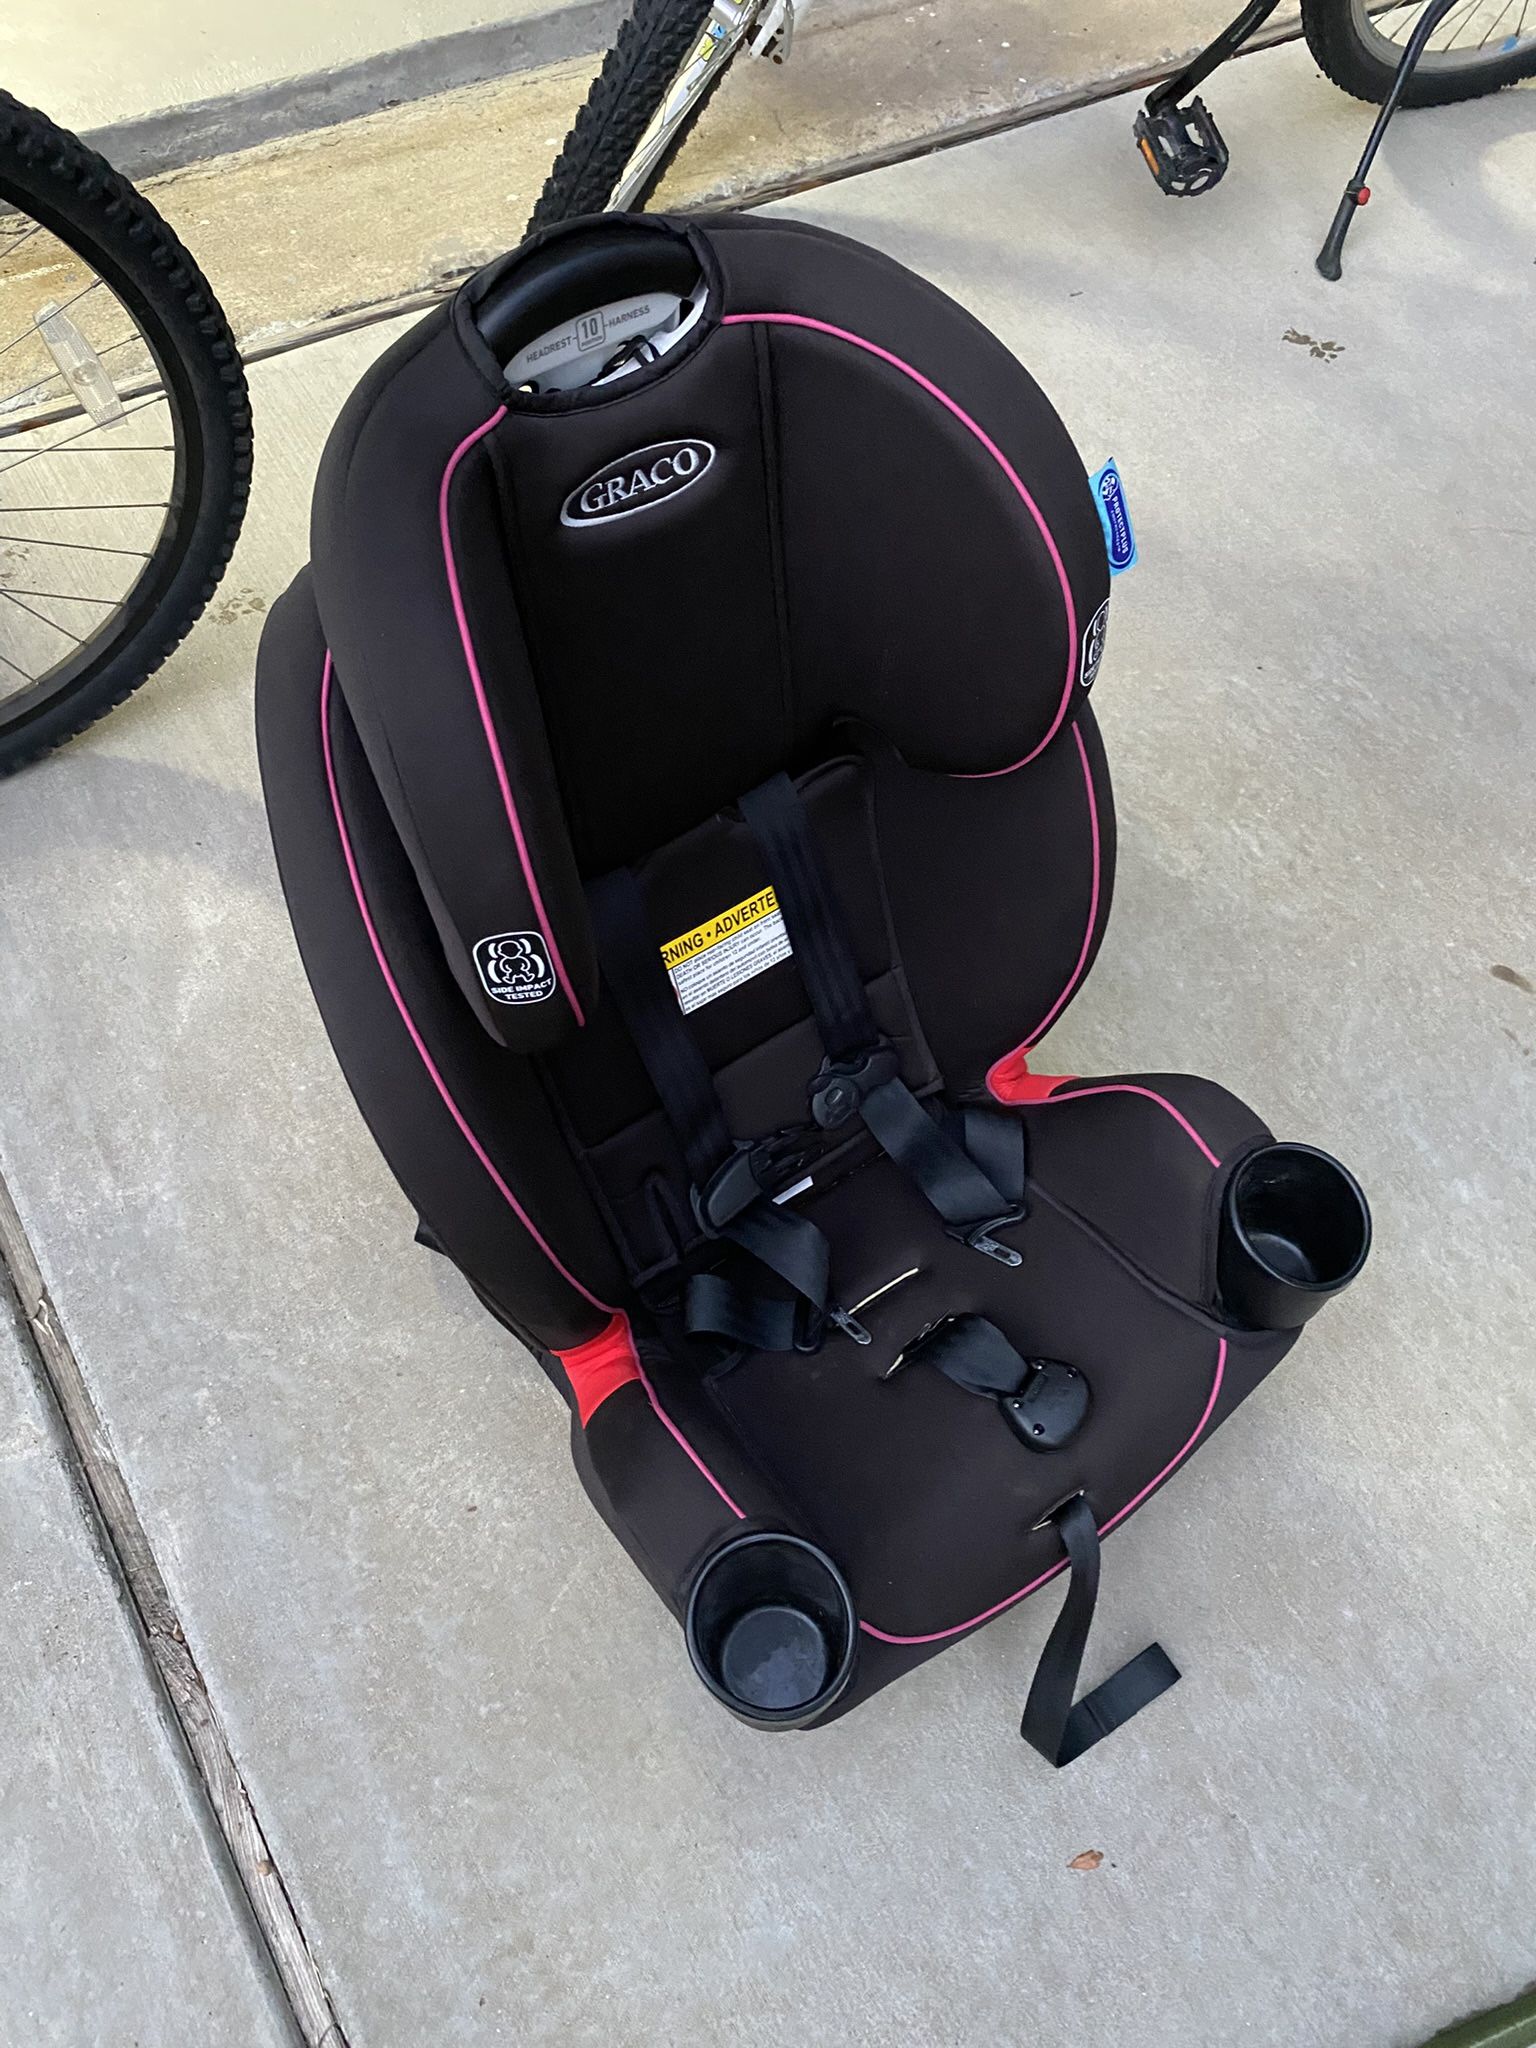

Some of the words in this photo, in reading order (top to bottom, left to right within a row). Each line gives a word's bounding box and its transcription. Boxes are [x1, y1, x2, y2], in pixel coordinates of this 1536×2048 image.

[526, 336, 572, 364] HEADREST
[581, 317, 598, 339] 10
[608, 305, 650, 328] HARNESS
[580, 447, 700, 513] GRACO
[715, 891, 776, 938] ADVERTE
[490, 985, 515, 994] SIDE
[515, 977, 552, 992] IMPACT
[504, 990, 544, 1000] TESTED
